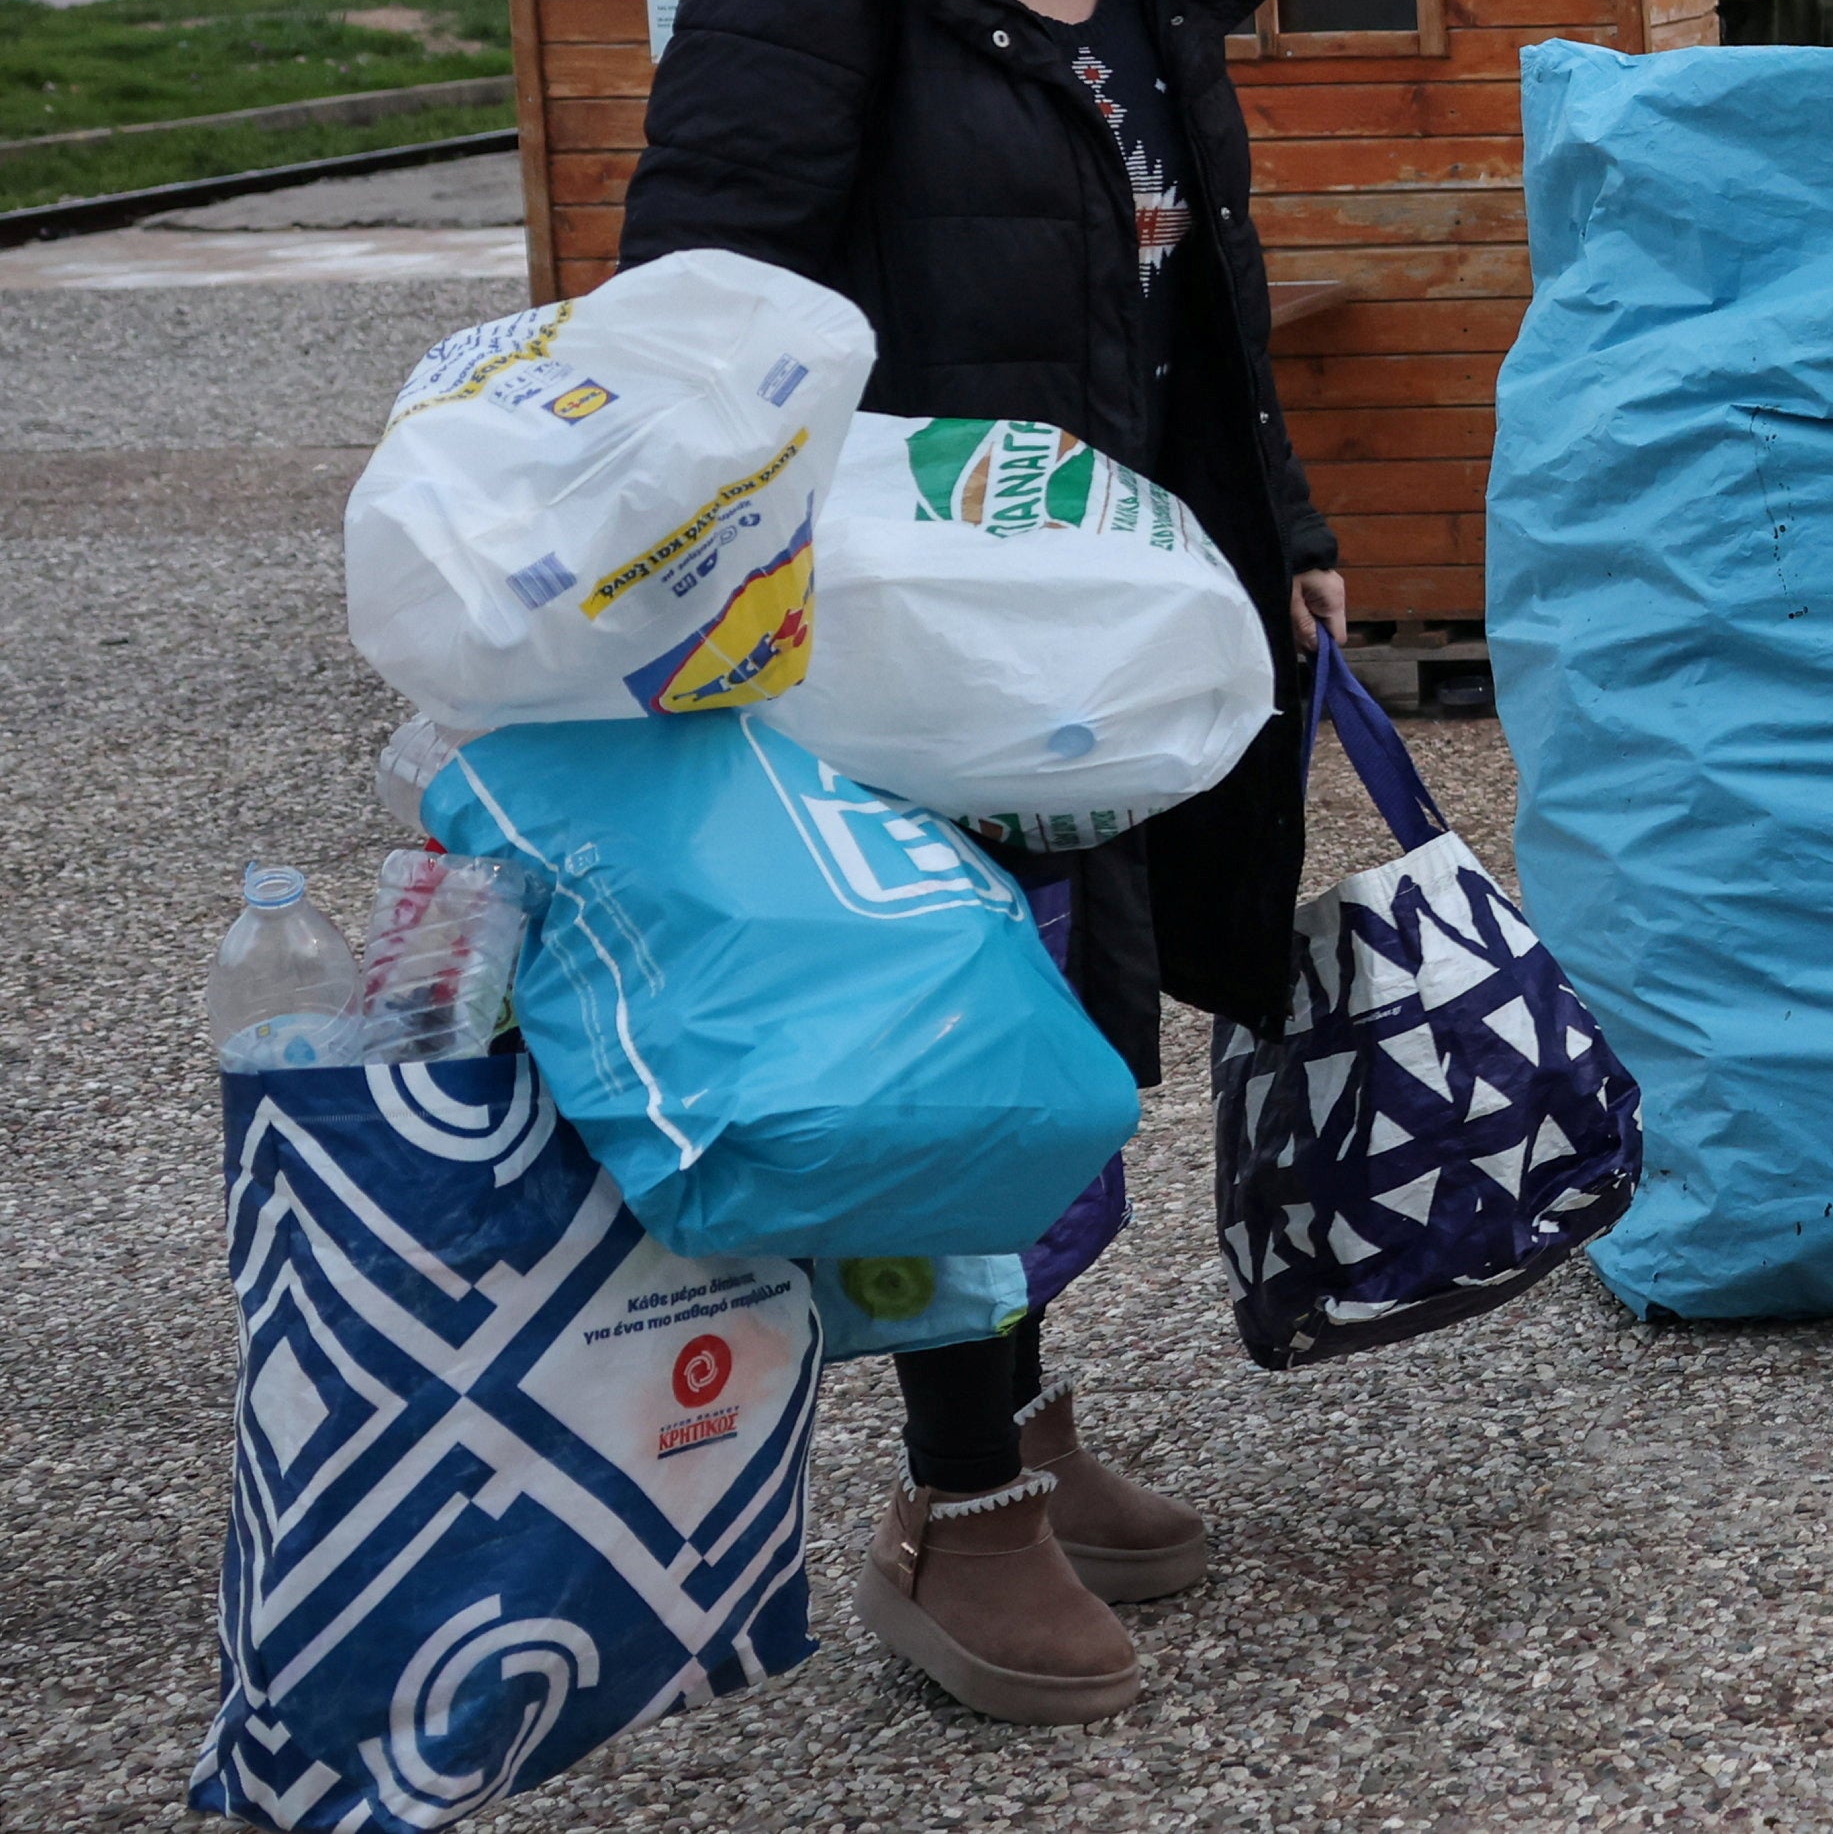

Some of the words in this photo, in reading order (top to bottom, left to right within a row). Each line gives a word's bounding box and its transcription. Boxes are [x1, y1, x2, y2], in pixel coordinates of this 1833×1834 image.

[627, 1294, 667, 1313] Κάθε
[671, 1284, 706, 1306] μέρα
[584, 1326, 610, 1345] για
[613, 1317, 644, 1337] ένα
[674, 1297, 728, 1324] καθαρό
[659, 1413, 738, 1451] ΚΡΗΤΙΚΟΣ
